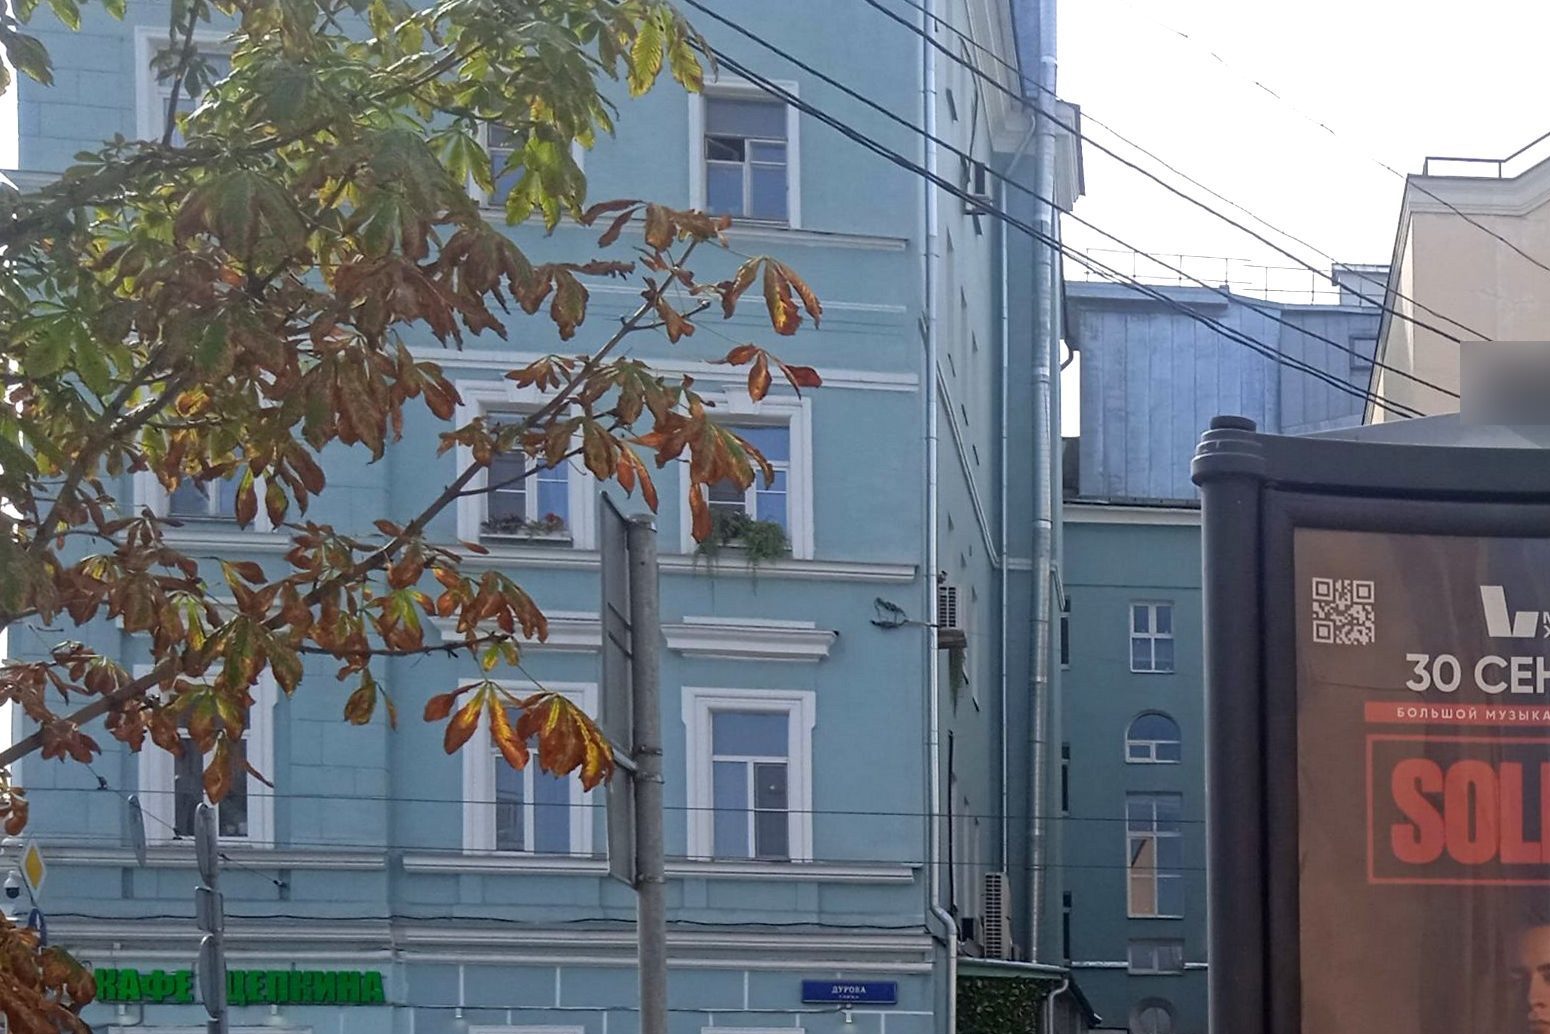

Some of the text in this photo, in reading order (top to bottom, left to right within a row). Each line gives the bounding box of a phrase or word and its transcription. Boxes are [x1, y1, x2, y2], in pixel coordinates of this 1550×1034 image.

[1405, 653, 1462, 693] 30
[1397, 707, 1477, 720] БОЛЬШОЙ
[95, 968, 194, 1003] КАФЕ
